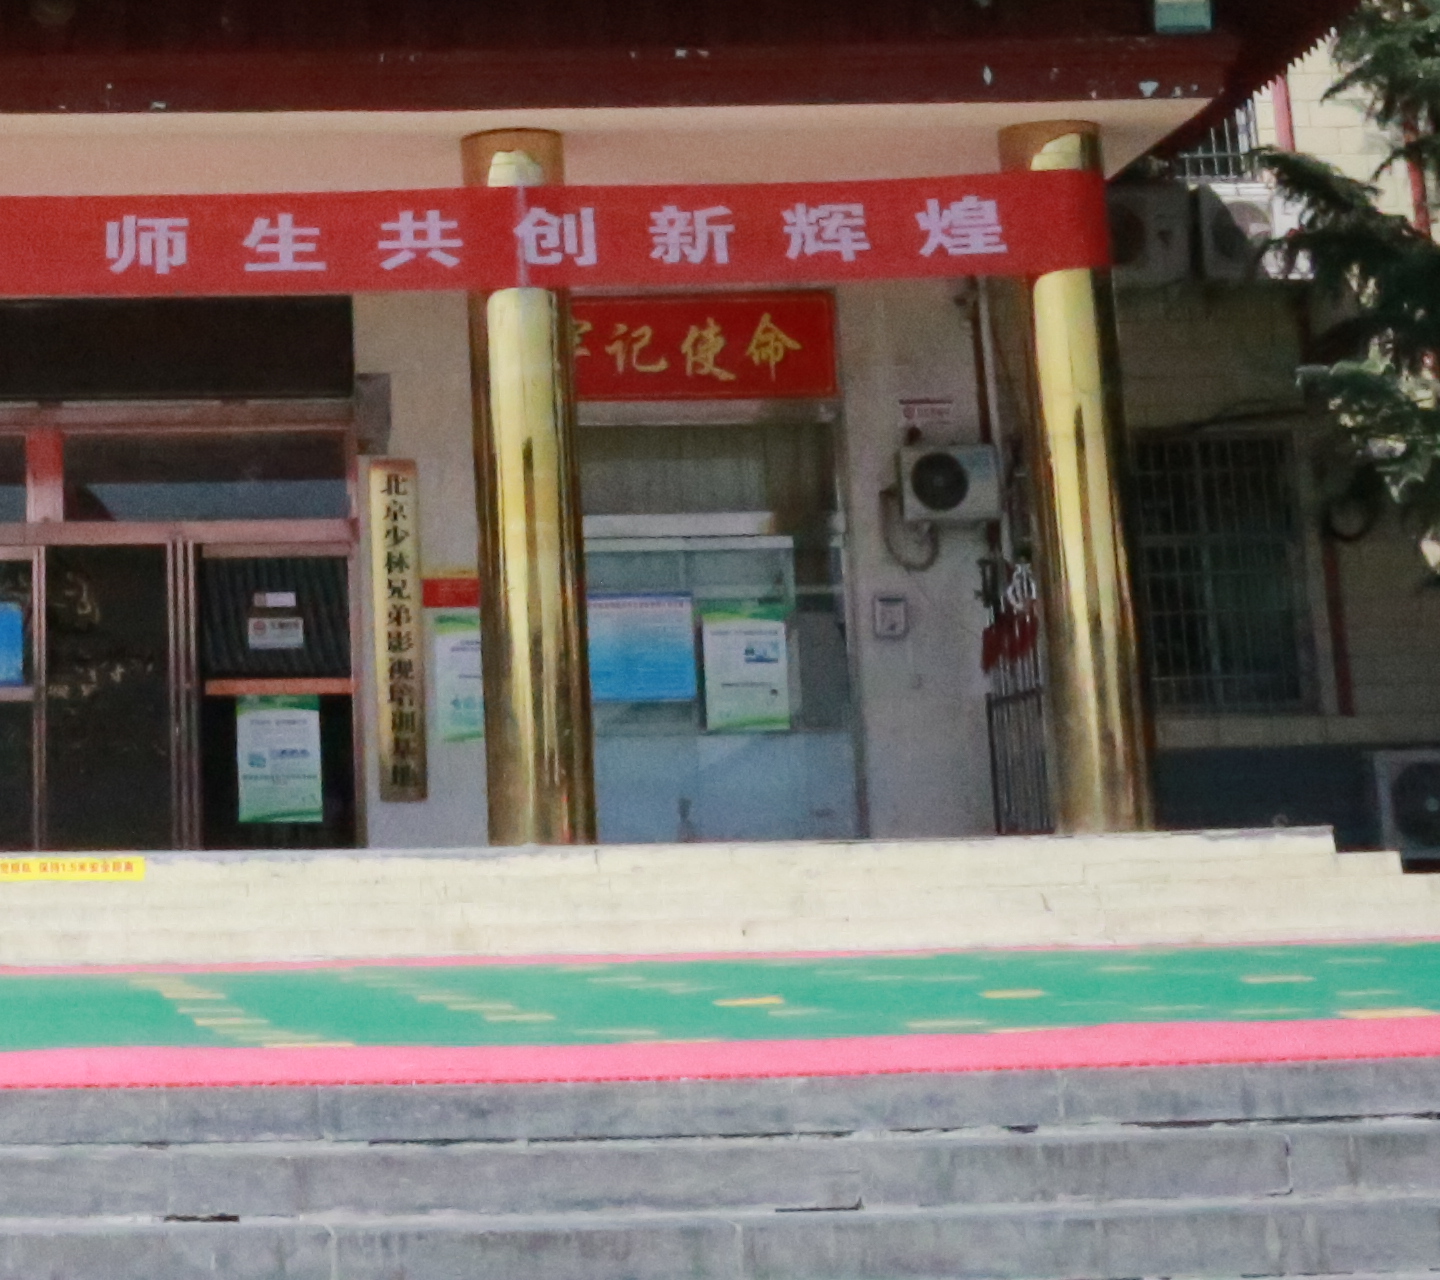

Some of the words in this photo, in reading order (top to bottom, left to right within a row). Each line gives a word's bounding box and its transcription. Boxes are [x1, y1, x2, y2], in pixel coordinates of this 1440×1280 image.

[104, 195, 1008, 275] 师生共创新辉煌
